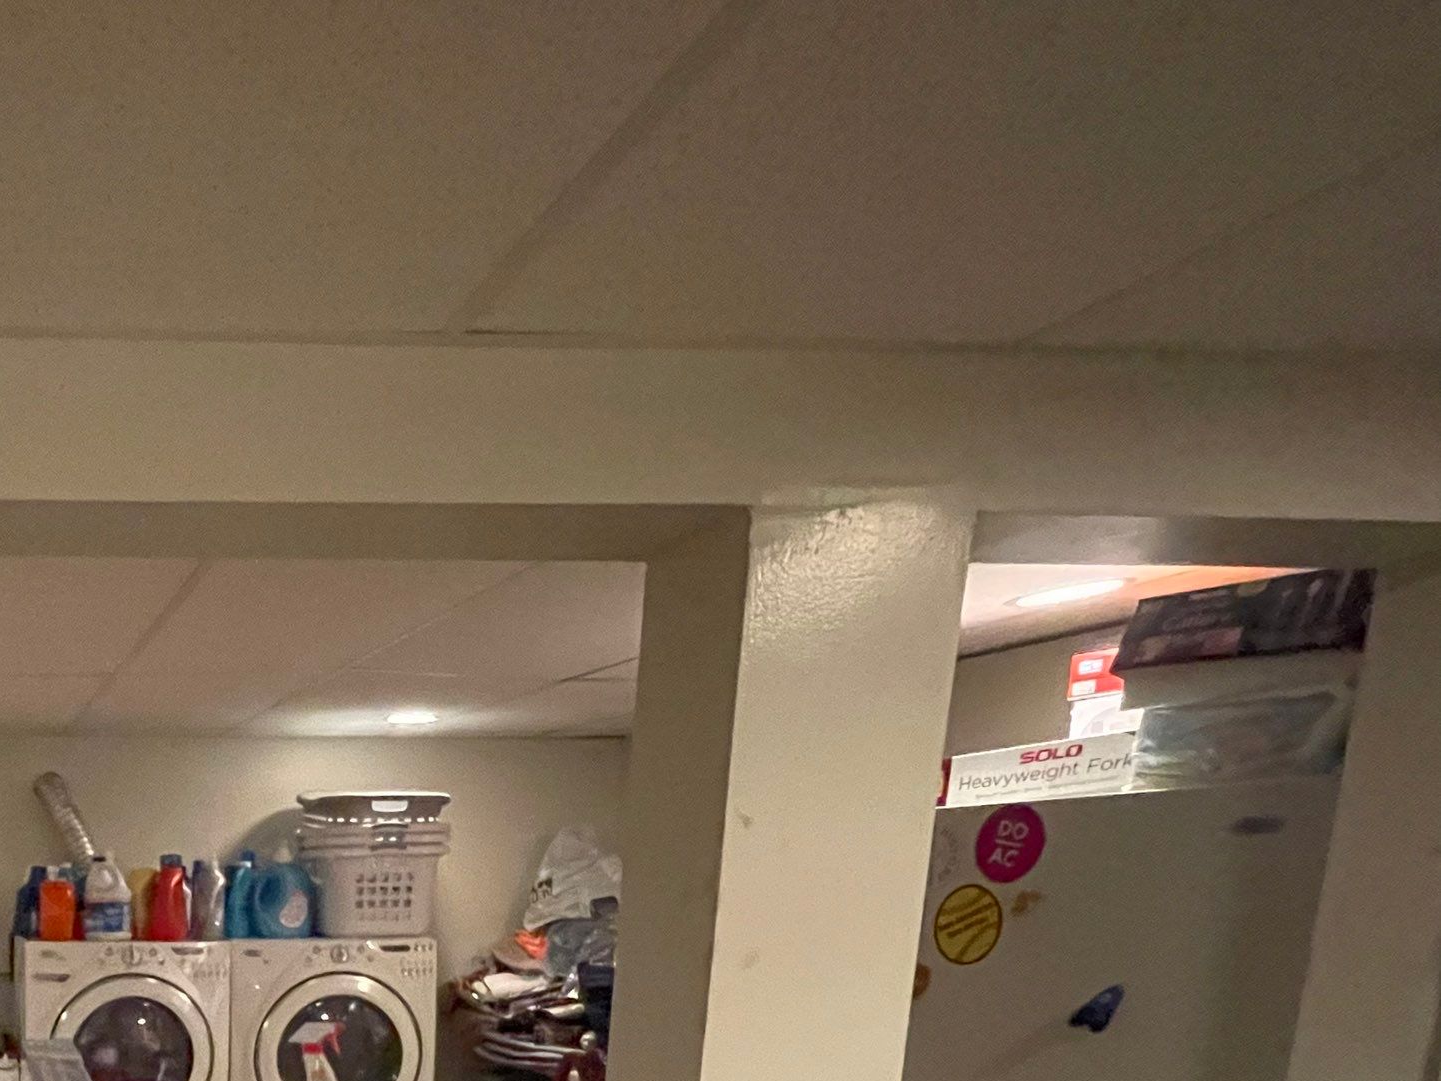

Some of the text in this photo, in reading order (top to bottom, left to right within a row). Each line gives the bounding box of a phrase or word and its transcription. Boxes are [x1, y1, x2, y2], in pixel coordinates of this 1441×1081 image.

[1019, 744, 1083, 765] SOLO
[959, 762, 1078, 791] Heavyweight
[997, 820, 1030, 840] DO
